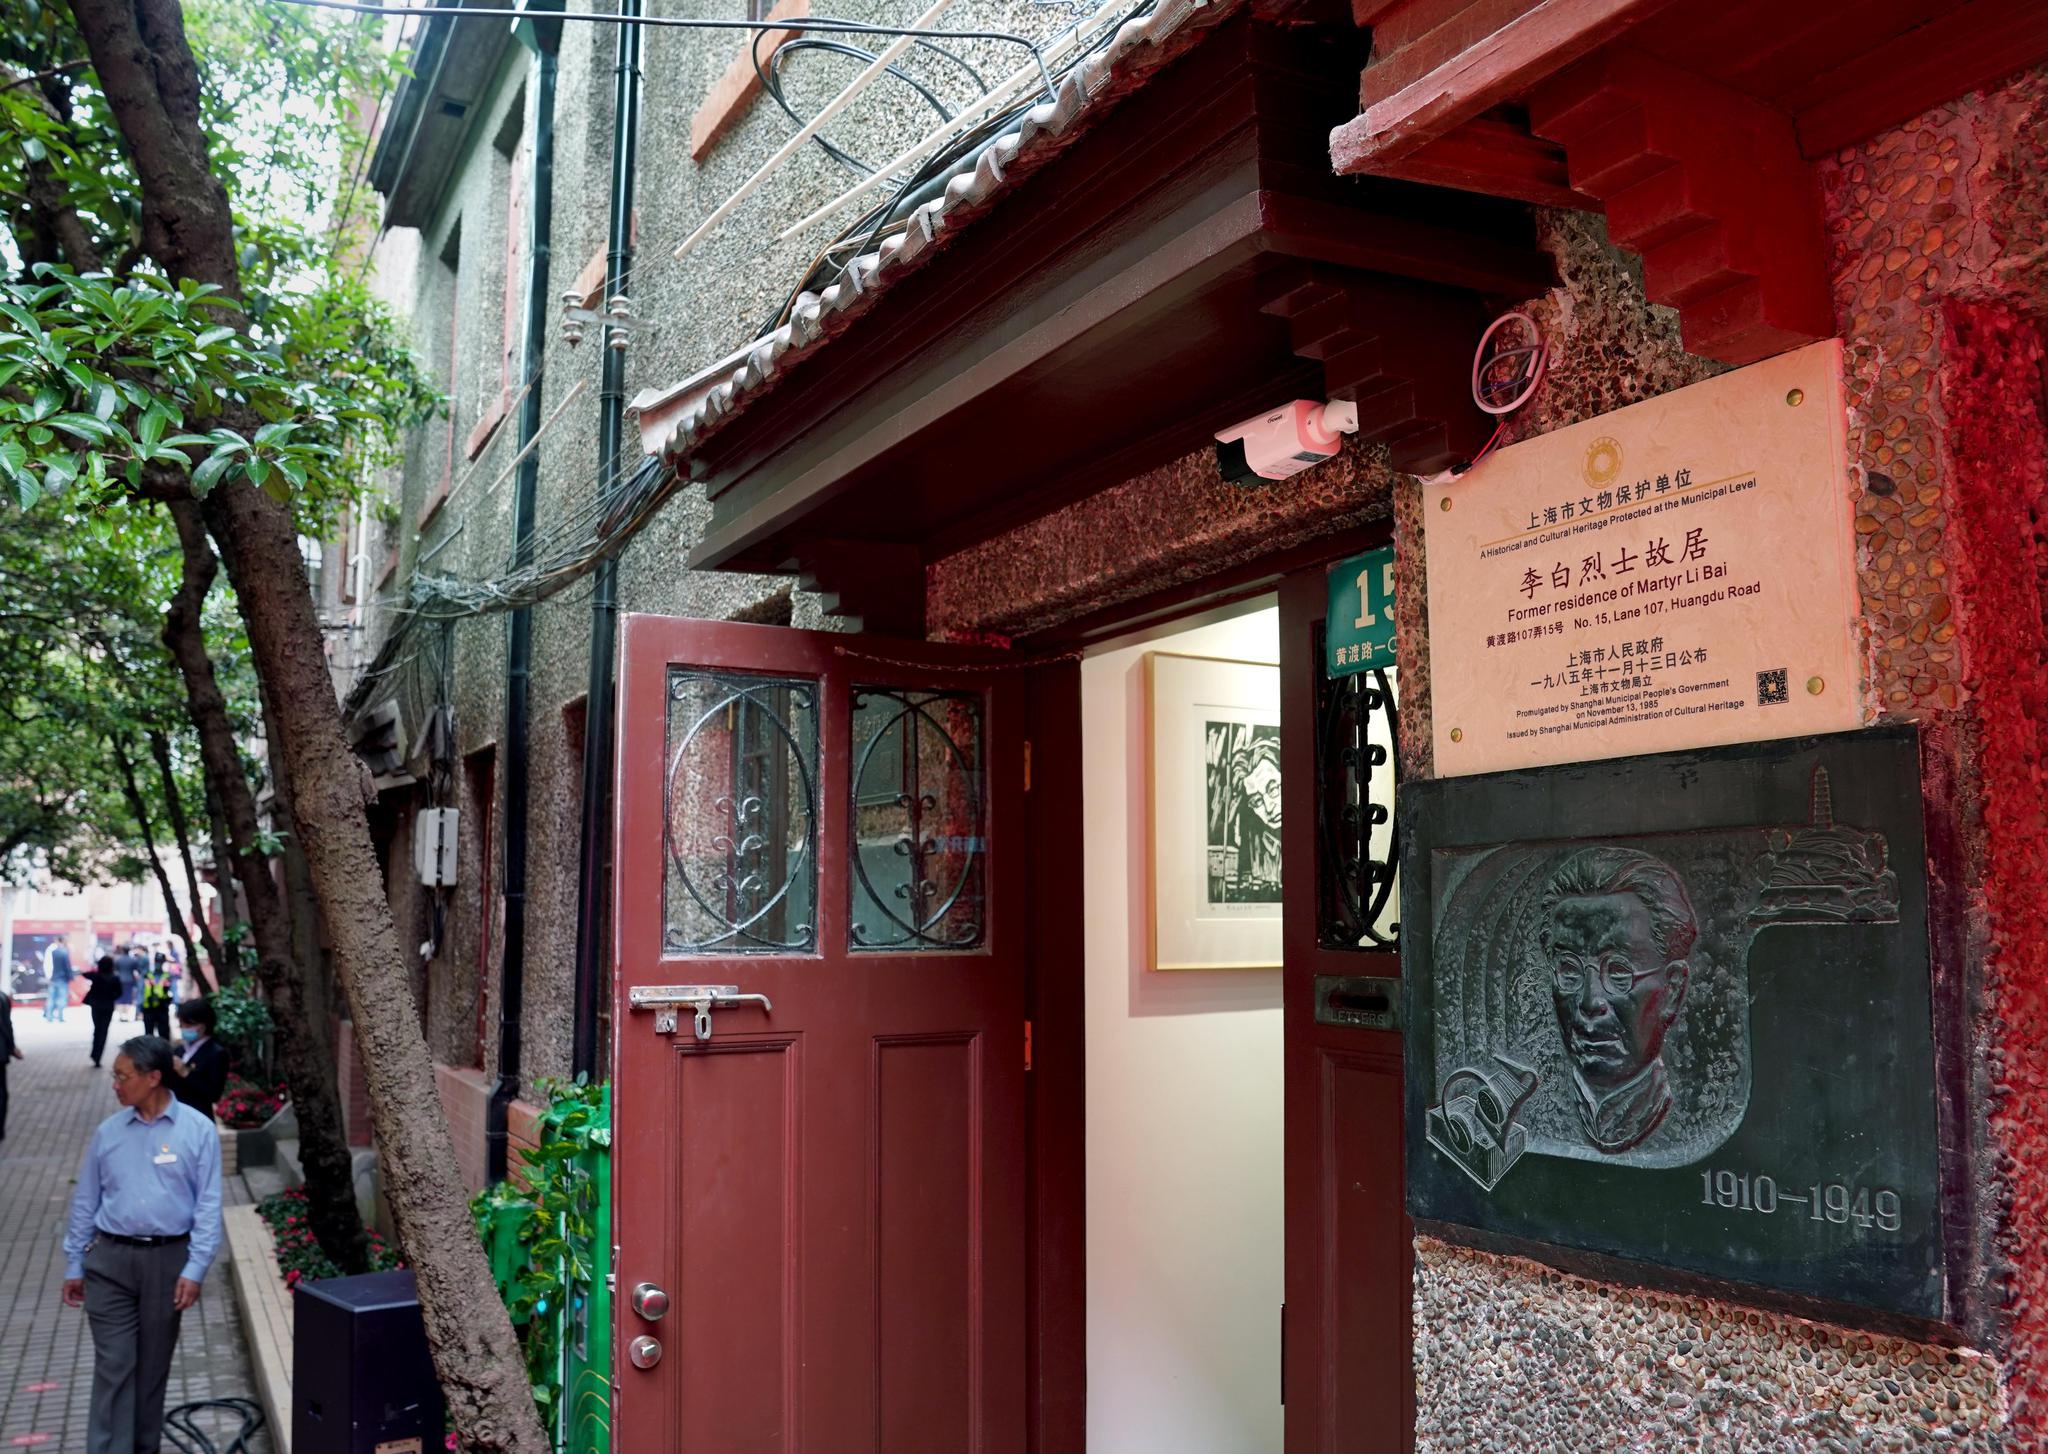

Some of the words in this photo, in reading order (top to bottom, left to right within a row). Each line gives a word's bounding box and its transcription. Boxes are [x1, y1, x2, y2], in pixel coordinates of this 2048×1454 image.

[1480, 550, 1486, 559] A
[1487, 541, 1522, 557] Historical
[1523, 537, 1538, 548] and
[1540, 528, 1571, 543] Cultural
[1573, 518, 1608, 534] Heritage
[1610, 506, 1652, 524] Protected
[1654, 503, 1663, 513] at
[1665, 499, 1679, 511] the
[1681, 486, 1727, 506] Municipal
[1729, 478, 1756, 493] Level
[1526, 468, 1692, 530] 上海市文物保护单位
[1519, 527, 1709, 600] 李白烈士故居
[1508, 603, 1552, 622] Former
[1554, 589, 1618, 613] residence
[1621, 582, 1634, 598] of
[1637, 574, 1682, 595] Martyr
[1686, 568, 1699, 584] Li
[1703, 562, 1727, 580] Bai
[1486, 621, 1564, 648] 黄渡路107弄15号
[1574, 618, 1592, 630] No.
[1595, 612, 1611, 625] 15,
[1613, 607, 1640, 622] Lane
[1643, 601, 1668, 616] 107,
[1671, 590, 1725, 610] Huangdu
[1727, 581, 1761, 598] Road
[1530, 647, 1708, 689] 一九八五年十一月十三日公布
[1566, 636, 1664, 668] 上海市人民政府
[1516, 704, 1559, 718] Promulgated
[1561, 703, 1569, 714] by
[1570, 698, 1604, 711] Shanghai
[1606, 691, 1641, 705] Municipal
[1678, 678, 1729, 694] Government
[1580, 675, 1652, 697] 上海市文物局立
[1507, 729, 1529, 739] Issued
[1530, 727, 1538, 737] by
[1539, 723, 1572, 735] Shanghai
[1573, 718, 1608, 731] Municipal
[1609, 709, 1663, 724] Administration
[1665, 708, 1673, 717] of
[1674, 703, 1707, 716] Cultural
[1708, 699, 1745, 712] Heritage
[1587, 705, 1624, 718] November
[1626, 703, 1638, 713] 13,
[1640, 699, 1659, 711] 1985
